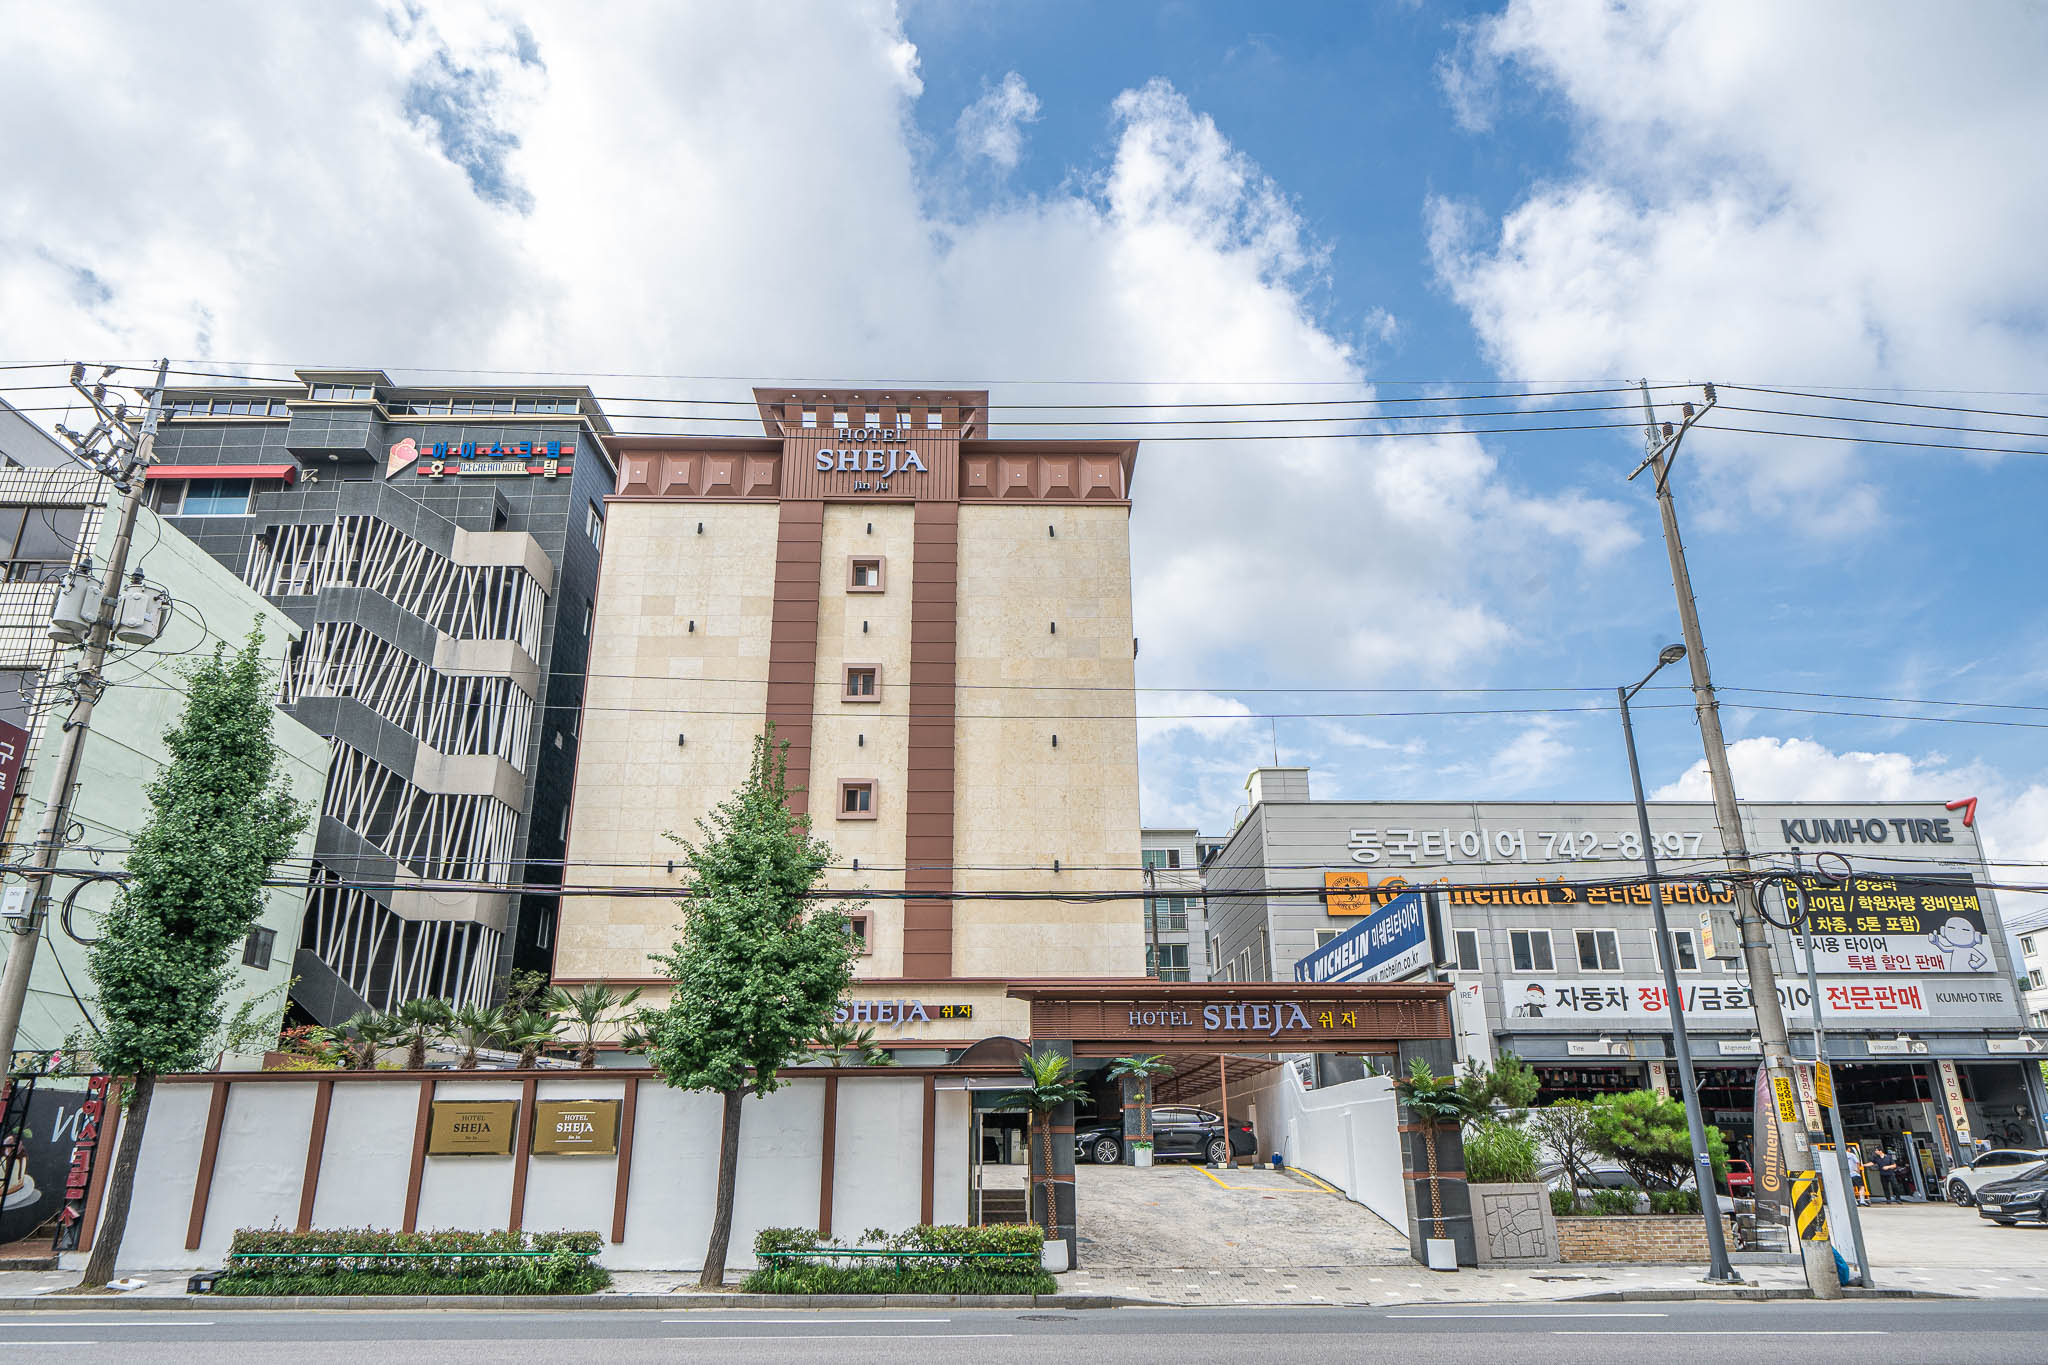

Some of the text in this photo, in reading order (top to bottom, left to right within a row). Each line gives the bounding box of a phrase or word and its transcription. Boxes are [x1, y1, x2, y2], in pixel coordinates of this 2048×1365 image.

[839, 429, 907, 443] HOTEL
[428, 461, 444, 478] 호
[816, 449, 928, 478] SHEJA
[1780, 817, 1954, 843] KUMHO TIRE
[1347, 827, 1528, 864] 동국타이어
[1857, 895, 1916, 912] 학원차량
[1920, 896, 1980, 912] 정비일체
[1816, 916, 1853, 933] 차종,
[1856, 916, 1882, 932] 5톤
[1885, 916, 1921, 933] 포함)
[1314, 898, 1420, 982] MICHELIN 미쉐린타이어
[1844, 936, 1888, 953] 타이어
[1847, 955, 1945, 971] 특별 할인 판매
[1555, 986, 1629, 1012] 자동차
[1826, 985, 1923, 1011] 전문판매
[1935, 992, 2004, 1003] KUMHO TIRE
[834, 1000, 931, 1030] SHEJA
[1128, 1011, 1193, 1026] HOTEL
[1203, 1004, 1312, 1037] SHEJA
[1942, 1063, 1962, 1116] 엔진오일
[453, 1123, 491, 1134] SHEJA
[556, 1122, 594, 1134] SHEJA
